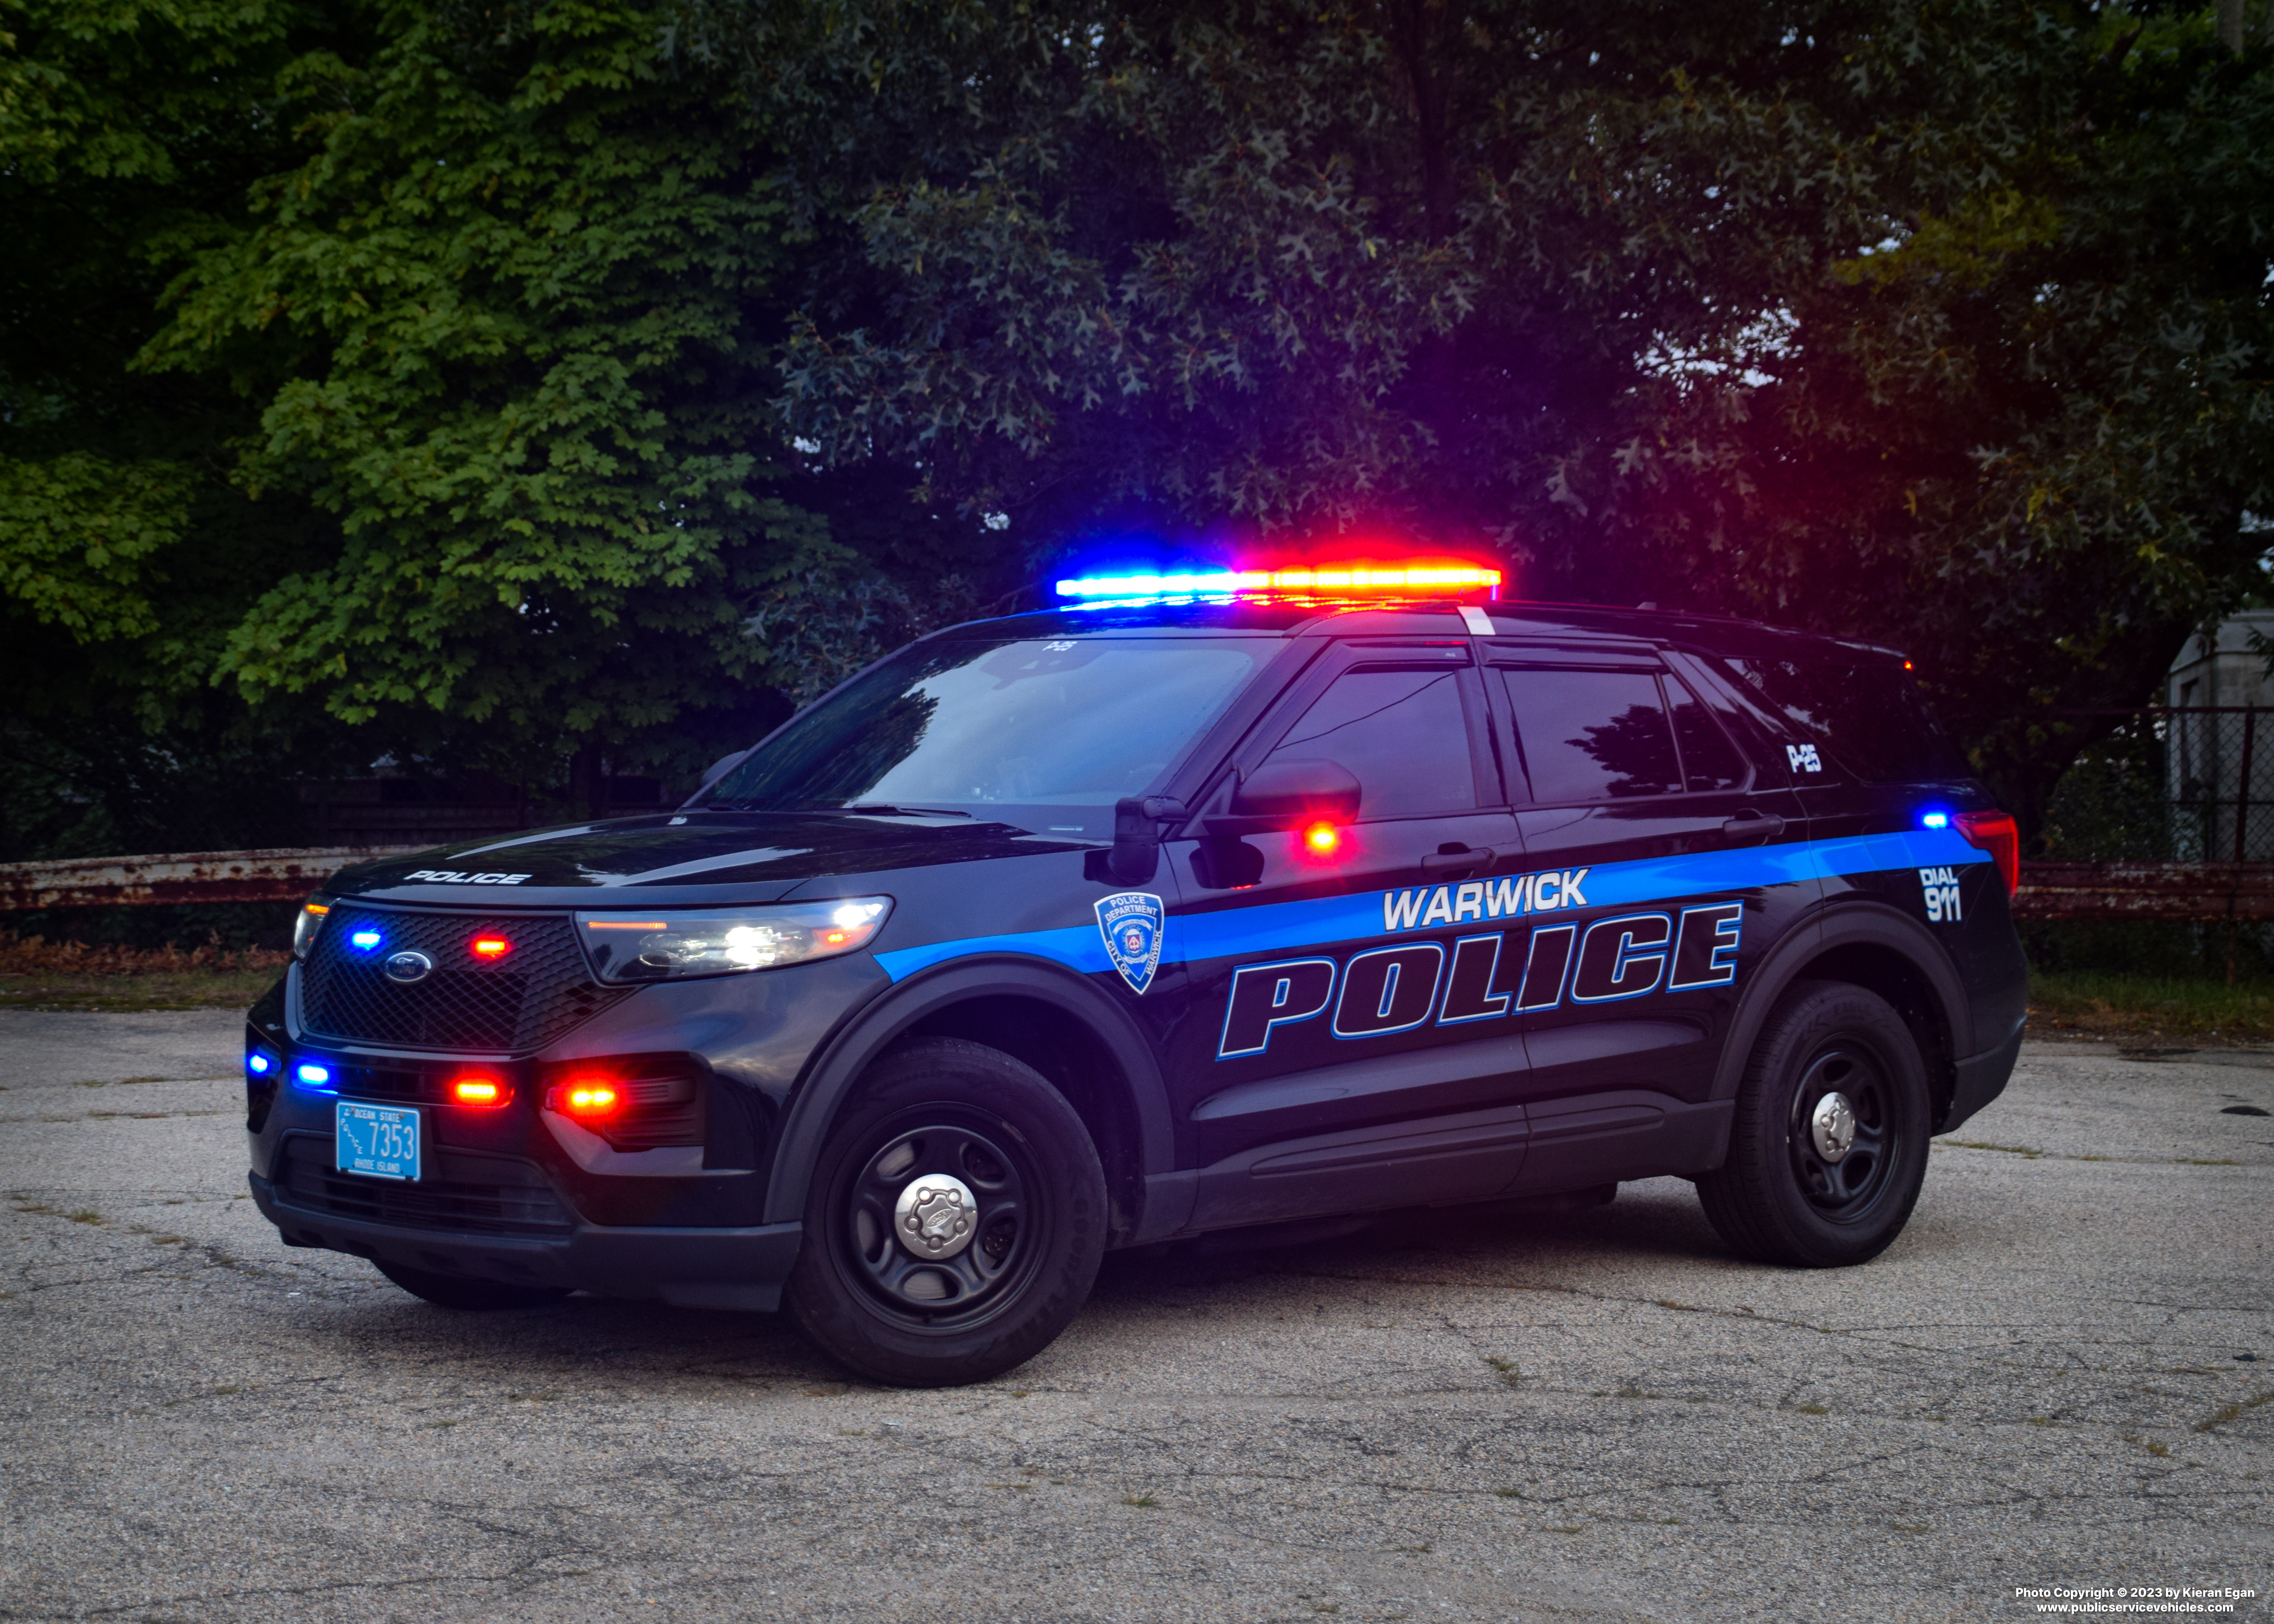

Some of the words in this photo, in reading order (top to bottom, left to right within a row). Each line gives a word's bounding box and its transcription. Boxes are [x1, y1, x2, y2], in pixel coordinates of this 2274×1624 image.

[1786, 744, 1822, 773] P-25
[403, 870, 533, 884] POLICE
[1919, 866, 1959, 886] DIAL
[1105, 905, 1158, 921] DEPARTMENT
[1110, 896, 1145, 908] POLICE
[1384, 868, 1589, 931] WARWICK
[1924, 886, 1962, 922] 911
[1107, 940, 1121, 962] CITY
[1120, 963, 1130, 975] OF
[1145, 930, 1161, 975] WARWICK
[1216, 900, 1744, 1061] POLICE
[354, 1109, 376, 1120] OCEAN
[380, 1112, 400, 1123] STATE
[341, 1118, 363, 1155] POLICE
[369, 1122, 414, 1160] 7353
[354, 1158, 375, 1170] RHODE
[377, 1161, 400, 1173] ISLAND
